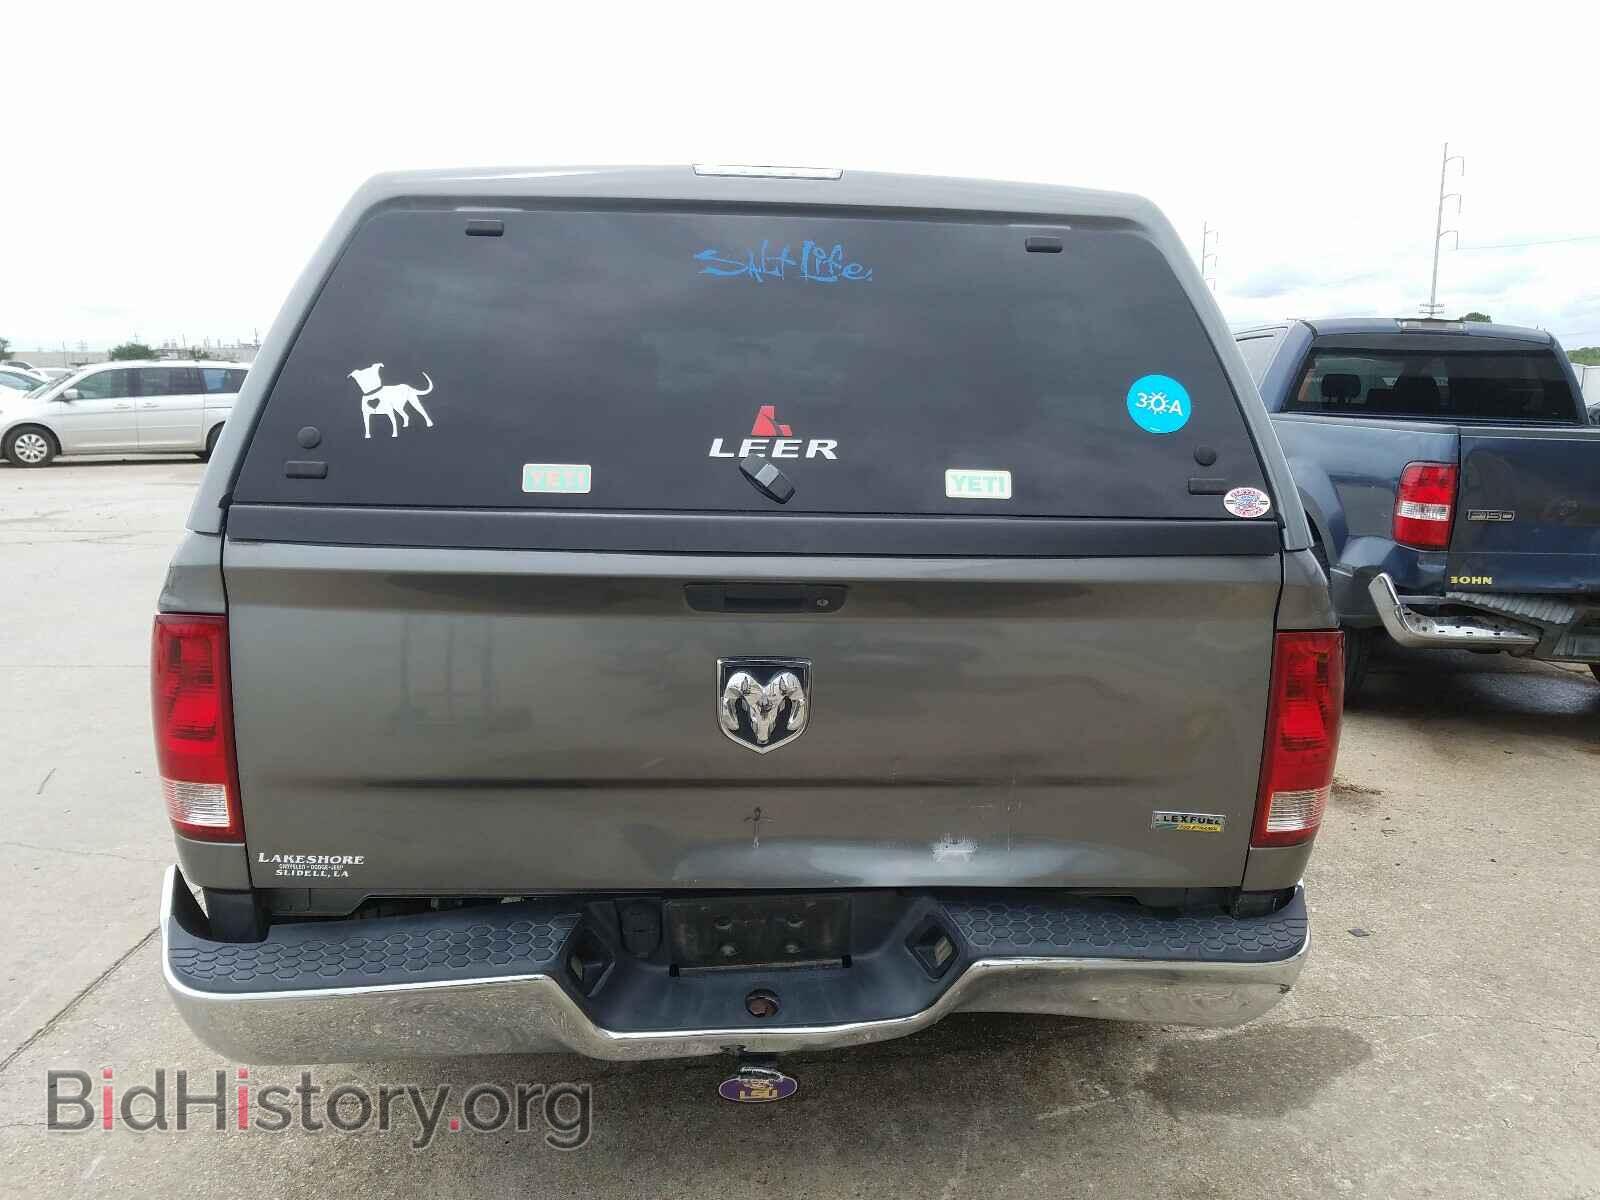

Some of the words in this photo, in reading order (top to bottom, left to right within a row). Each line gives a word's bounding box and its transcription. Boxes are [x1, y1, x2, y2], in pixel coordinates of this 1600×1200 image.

[708, 438, 839, 460] LEER
[529, 471, 585, 488] YETI
[950, 475, 1005, 493] YETI
[258, 853, 366, 864] LAKESHORE
